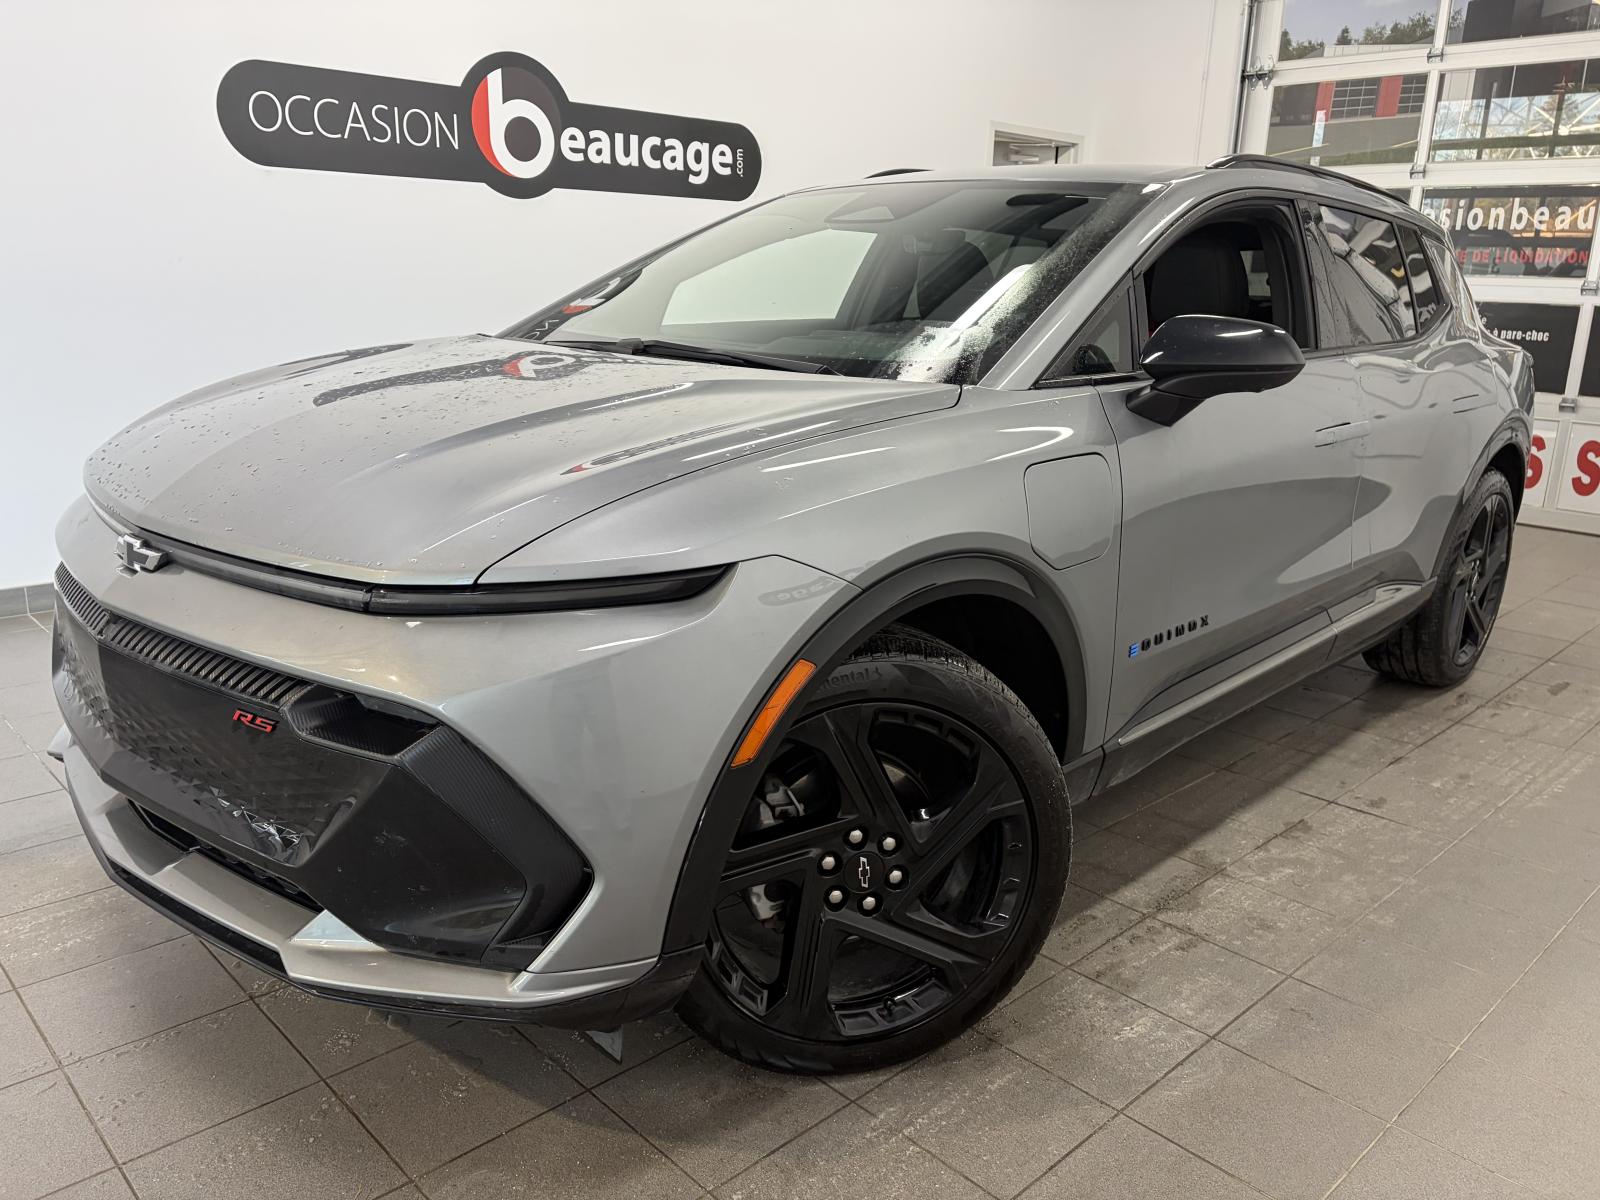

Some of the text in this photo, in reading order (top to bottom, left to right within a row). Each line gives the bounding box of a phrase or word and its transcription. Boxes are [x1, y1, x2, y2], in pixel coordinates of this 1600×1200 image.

[248, 90, 459, 150] OCCASION
[1128, 615, 1209, 658] EQUINOX
[232, 709, 278, 734] RS
